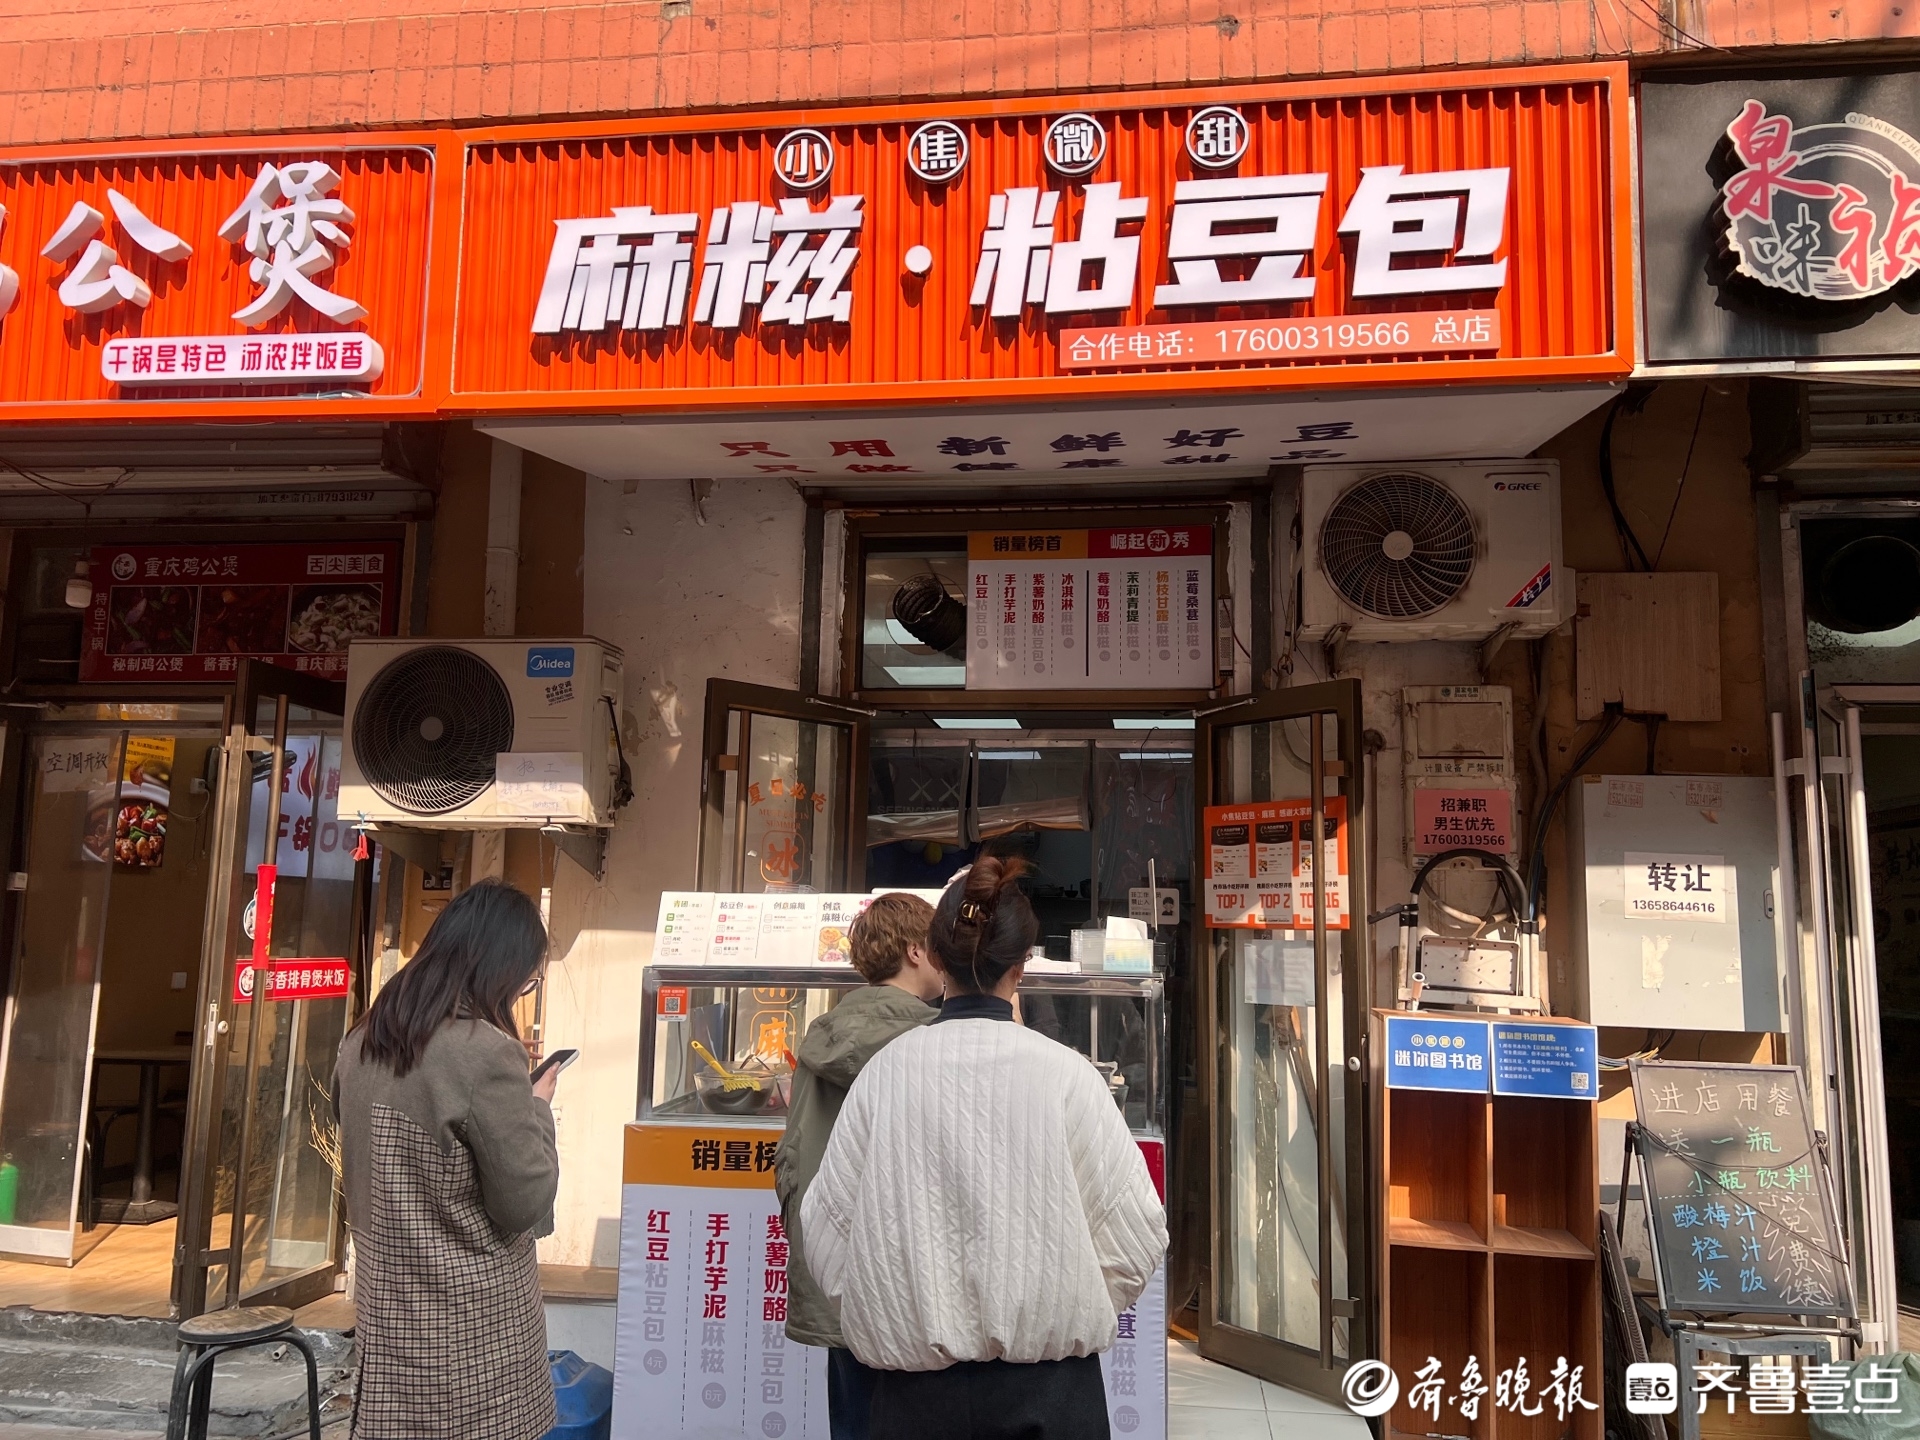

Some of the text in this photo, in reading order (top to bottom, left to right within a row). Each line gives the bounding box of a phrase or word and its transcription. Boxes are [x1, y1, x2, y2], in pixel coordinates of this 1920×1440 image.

[0, 160, 370, 326] 公煲
[1214, 320, 1410, 353] 17600319566
[1431, 315, 1492, 345] 总店
[240, 340, 364, 372] 汤浓拌饭香
[719, 421, 1360, 458] 只用新鲜好豆
[1507, 482, 1542, 491] GREE
[993, 535, 1062, 552] 销量榜首
[1109, 530, 1190, 551] 崛起新秀
[144, 556, 239, 577] 重庆鸡公煲
[307, 554, 384, 574] 舌尖美食
[92, 592, 108, 651] 特色干锅
[112, 656, 184, 673] 秘制鸡公煲
[530, 655, 571, 671] Midea
[46, 751, 108, 773] 空调开放
[1425, 762, 1504, 773] 计量设备 严禁拆封
[1440, 798, 1487, 813] 招兼职
[1433, 816, 1495, 831] 男生优先
[1423, 833, 1505, 846] 17600319566
[766, 837, 800, 877] 冰
[1647, 862, 1712, 892] 转让
[1216, 893, 1245, 909] TOP 1
[1259, 893, 1291, 909] TOP 2
[1632, 899, 1715, 913] 13658644616
[1394, 1049, 1483, 1071] 迷你图书馆
[1672, 1202, 1757, 1231] 酸梅汁
[642, 1209, 671, 1343] 红豆粘豆包
[700, 1213, 730, 1375] 手打芋泥麻糍
[760, 1214, 789, 1405] 紫薯奶酪粘豆包
